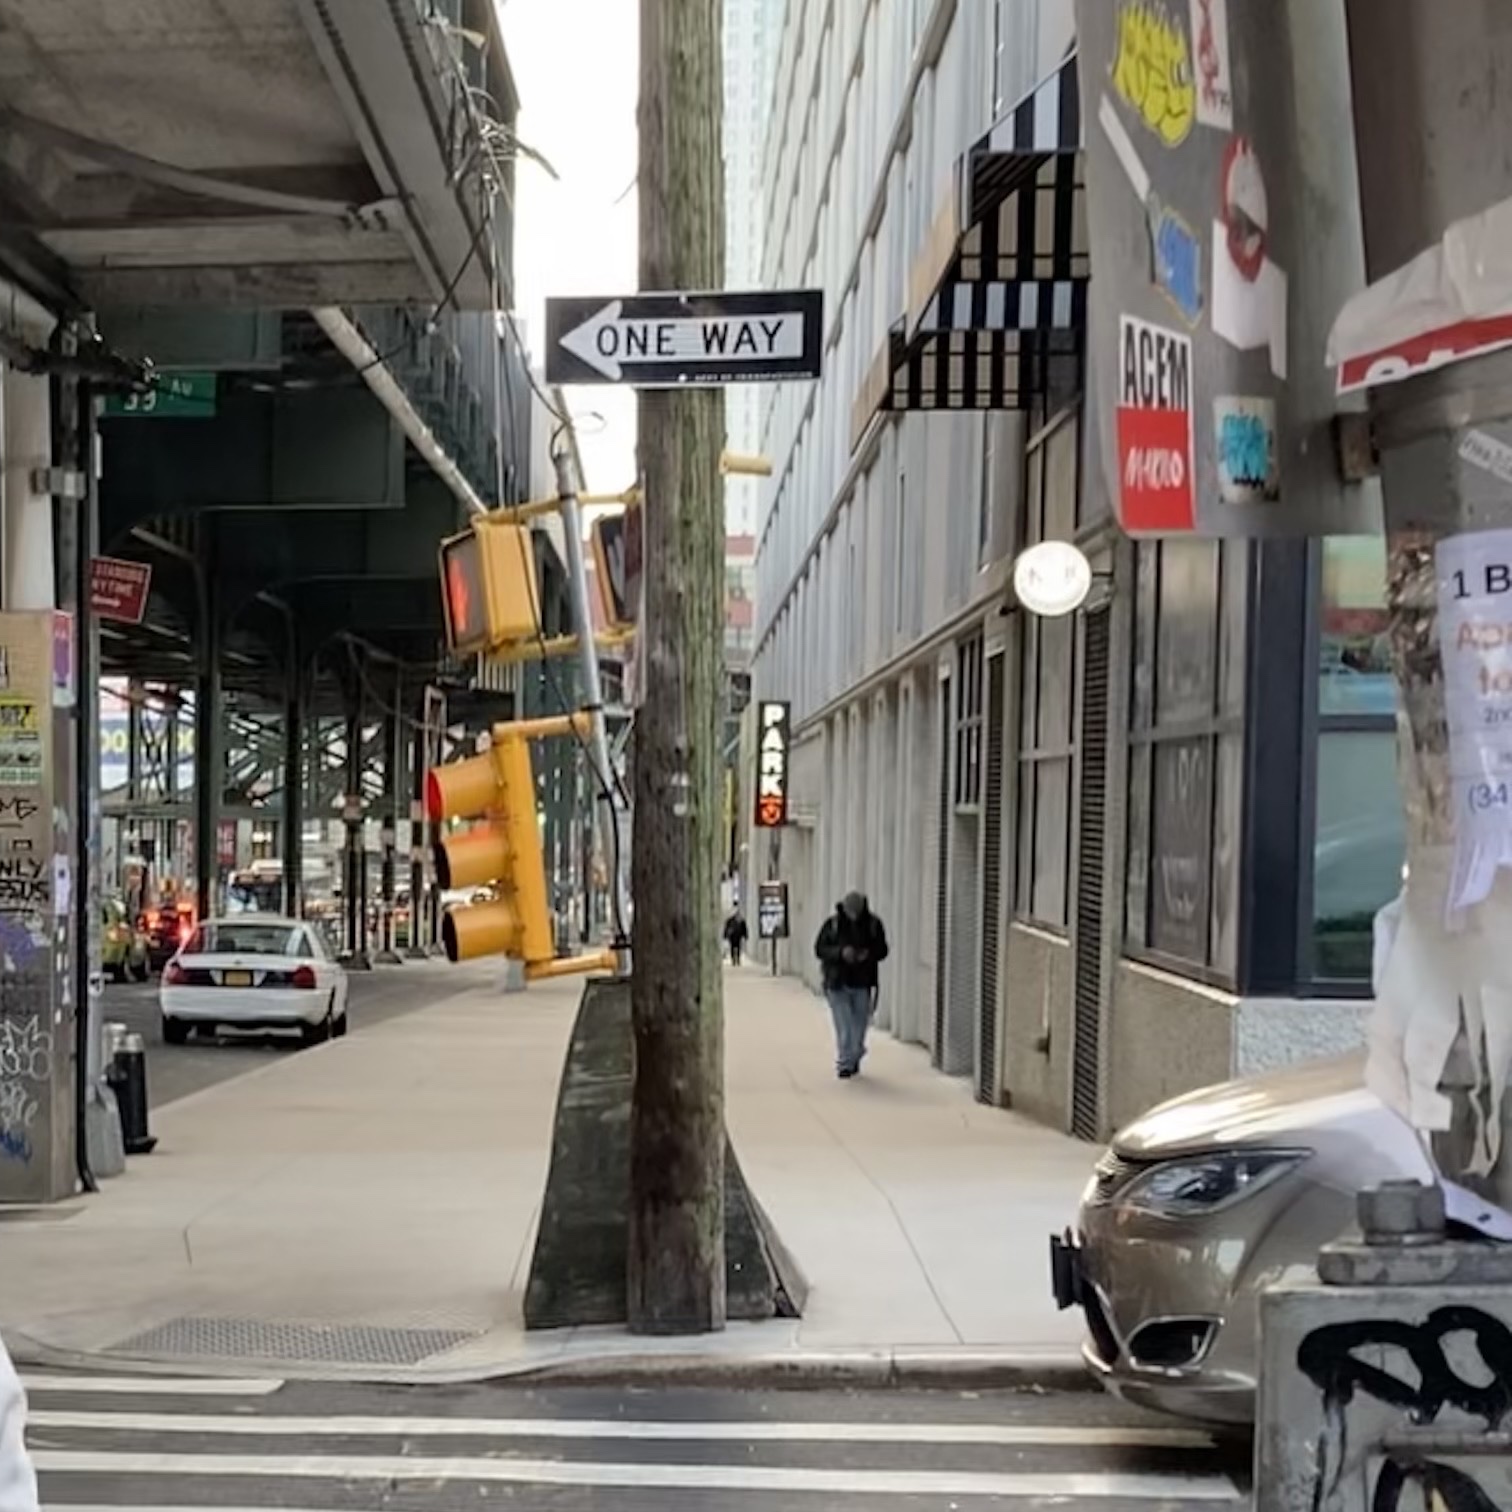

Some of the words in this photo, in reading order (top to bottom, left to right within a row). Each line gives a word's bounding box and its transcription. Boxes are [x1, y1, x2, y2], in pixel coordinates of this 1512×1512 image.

[596, 324, 676, 357] ONE
[703, 319, 784, 354] WAY
[761, 703, 786, 797] PARK
